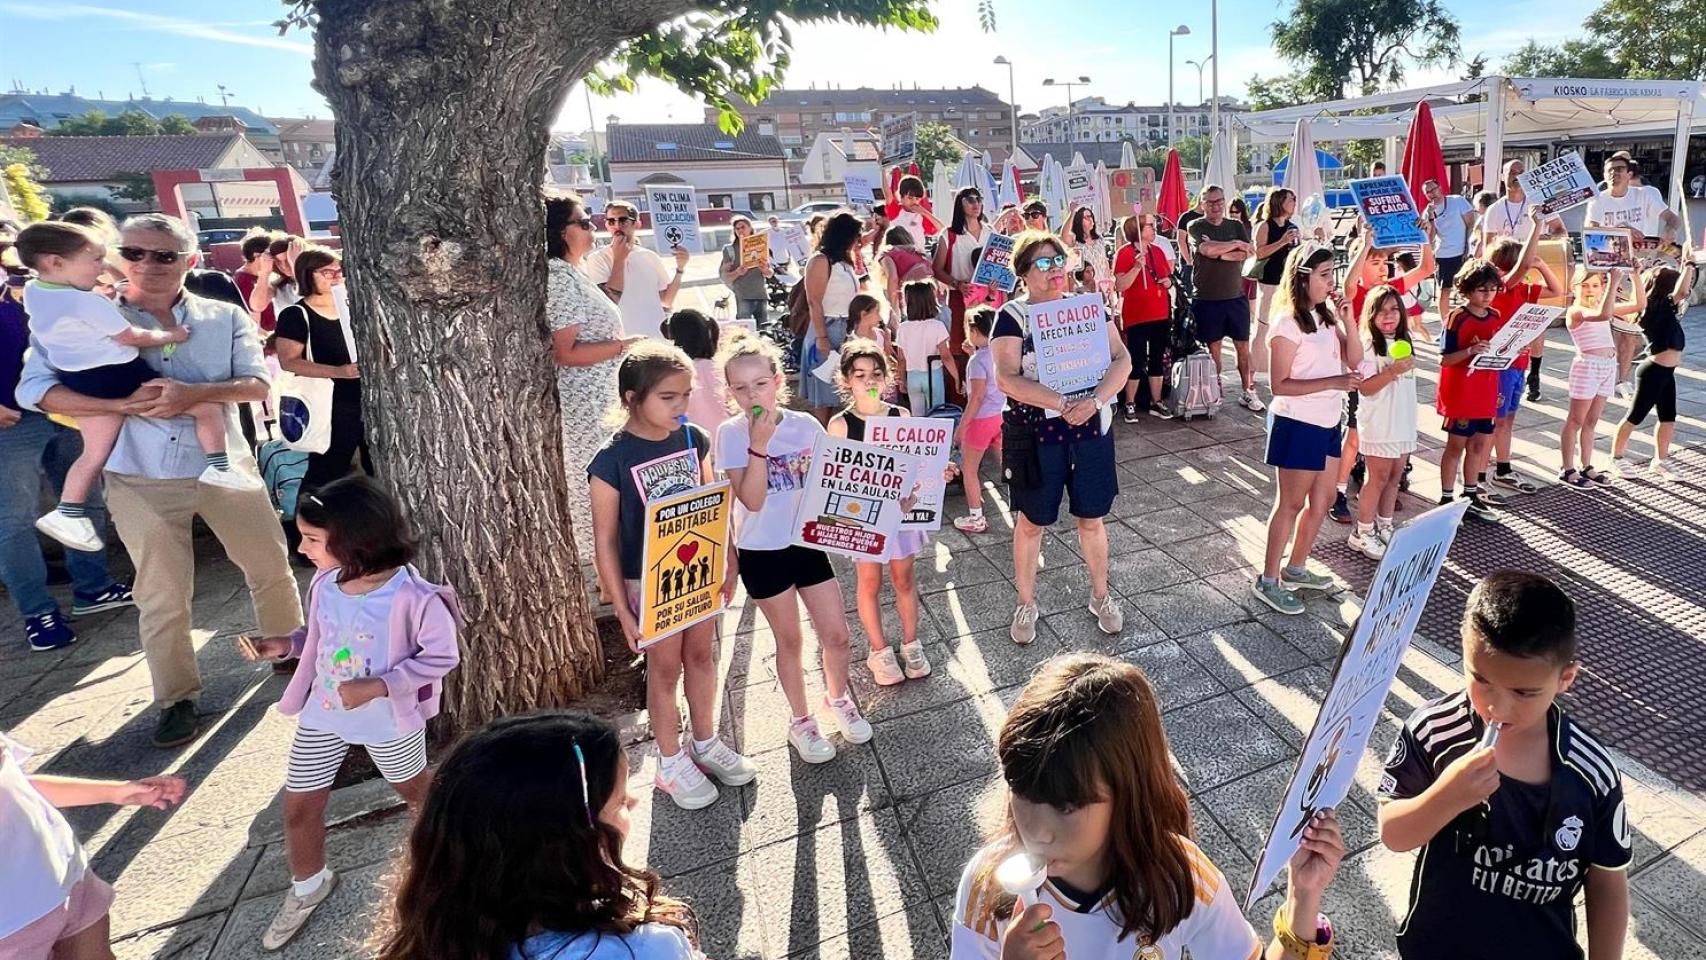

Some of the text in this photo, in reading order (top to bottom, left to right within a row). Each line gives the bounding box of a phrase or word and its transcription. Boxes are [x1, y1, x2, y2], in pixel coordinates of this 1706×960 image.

[1553, 86, 1588, 96] KIOSKO
[1590, 87, 1598, 96] LA
[1543, 162, 1577, 179] CALOR
[653, 192, 690, 202] SIN CLIMA
[1369, 195, 1402, 205] SUFRIR
[661, 203, 688, 212] NO HAY
[1368, 203, 1409, 215] DE CALOR
[1037, 304, 1100, 328] EL CALOR
[1040, 322, 1096, 341] AFECTA A SU
[873, 427, 946, 443] EL CALOR
[835, 447, 895, 472] ¡BASTA
[914, 446, 921, 455] A
[925, 446, 938, 456] SU
[823, 463, 903, 489] DE CALOR
[821, 478, 901, 501] EN LAS AULAS!
[660, 494, 721, 521] POR UN COLEGIO
[658, 507, 720, 539] HABITABLE
[916, 512, 929, 521] YA!
[816, 524, 876, 540] NUESTROS HIJOS
[816, 531, 838, 540] HIJAS
[851, 537, 879, 547] PUEDEN
[816, 537, 854, 549] APRENDER
[1371, 541, 1443, 619] SIN CLIMA
[655, 599, 713, 632] POR SU FUTURO
[657, 606, 672, 620] POR
[674, 601, 685, 613] SU
[1472, 867, 1563, 906] FLY BETTER
